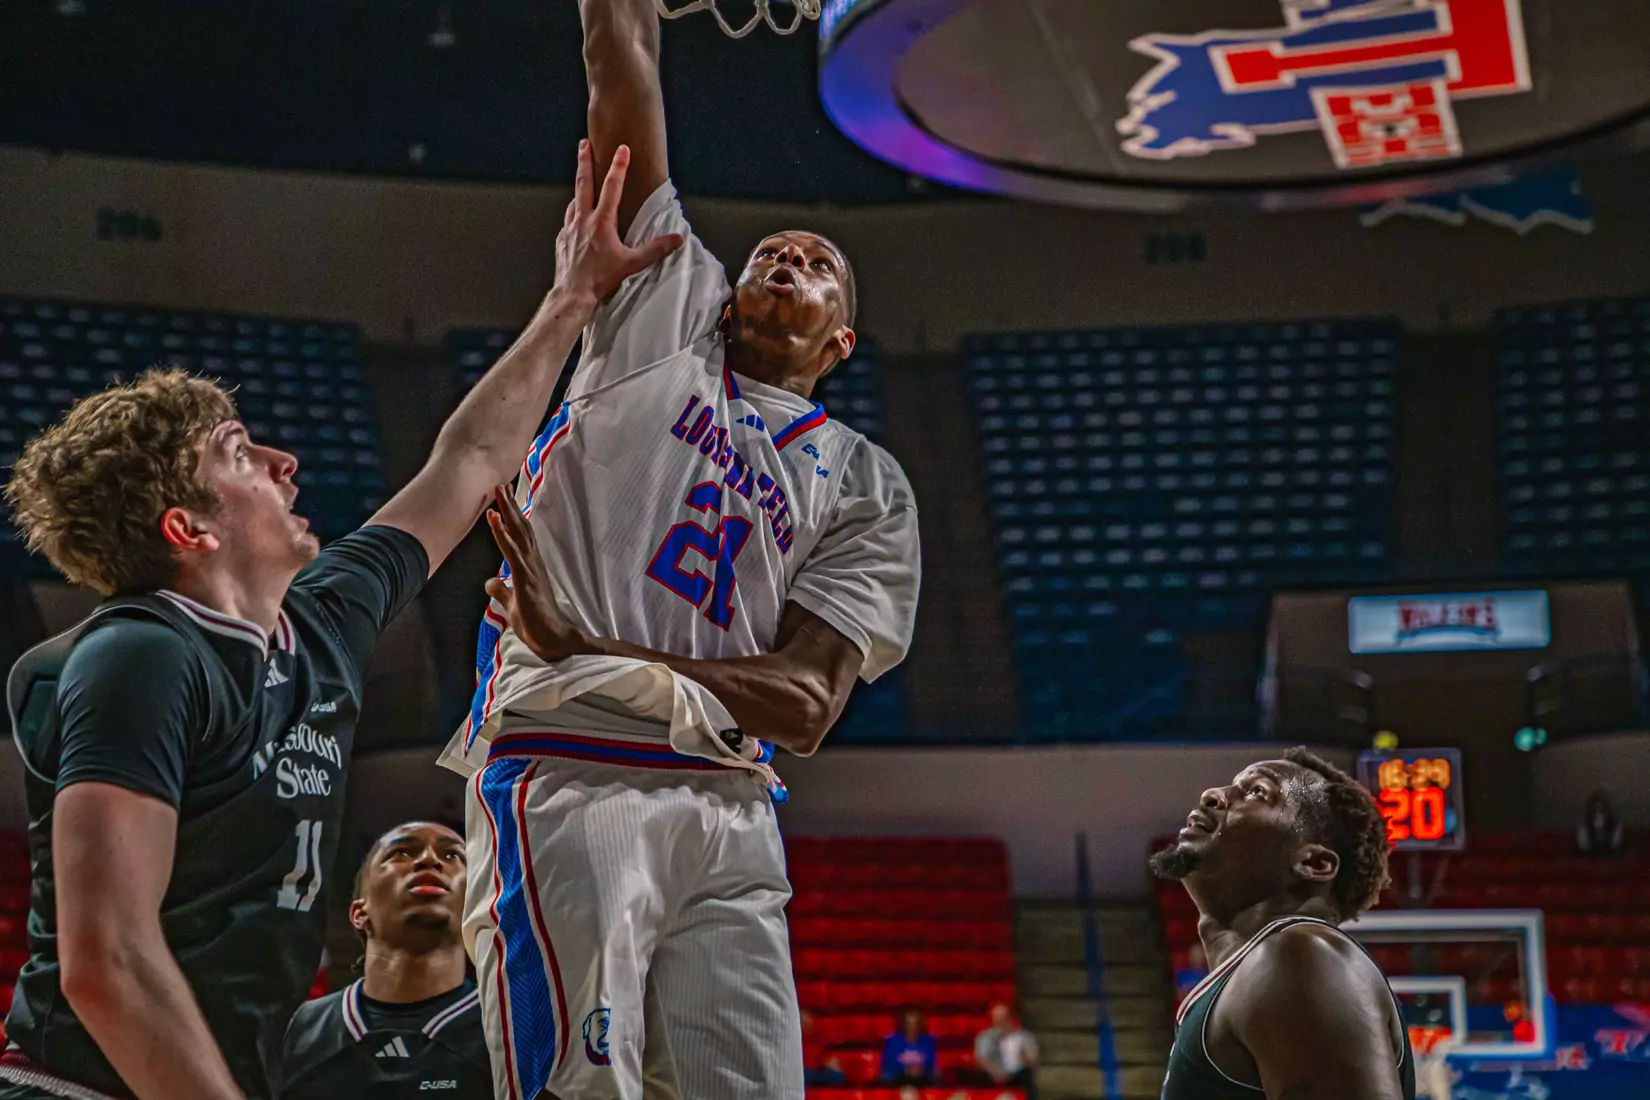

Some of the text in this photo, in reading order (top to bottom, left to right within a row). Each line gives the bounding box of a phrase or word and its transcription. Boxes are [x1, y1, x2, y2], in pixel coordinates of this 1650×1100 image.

[644, 480, 754, 632] 21
[252, 722, 342, 780] Mssouri
[276, 756, 332, 799] State
[1377, 786, 1445, 841] 20
[277, 818, 323, 912] 11
[419, 1079, 457, 1090] C-USA
